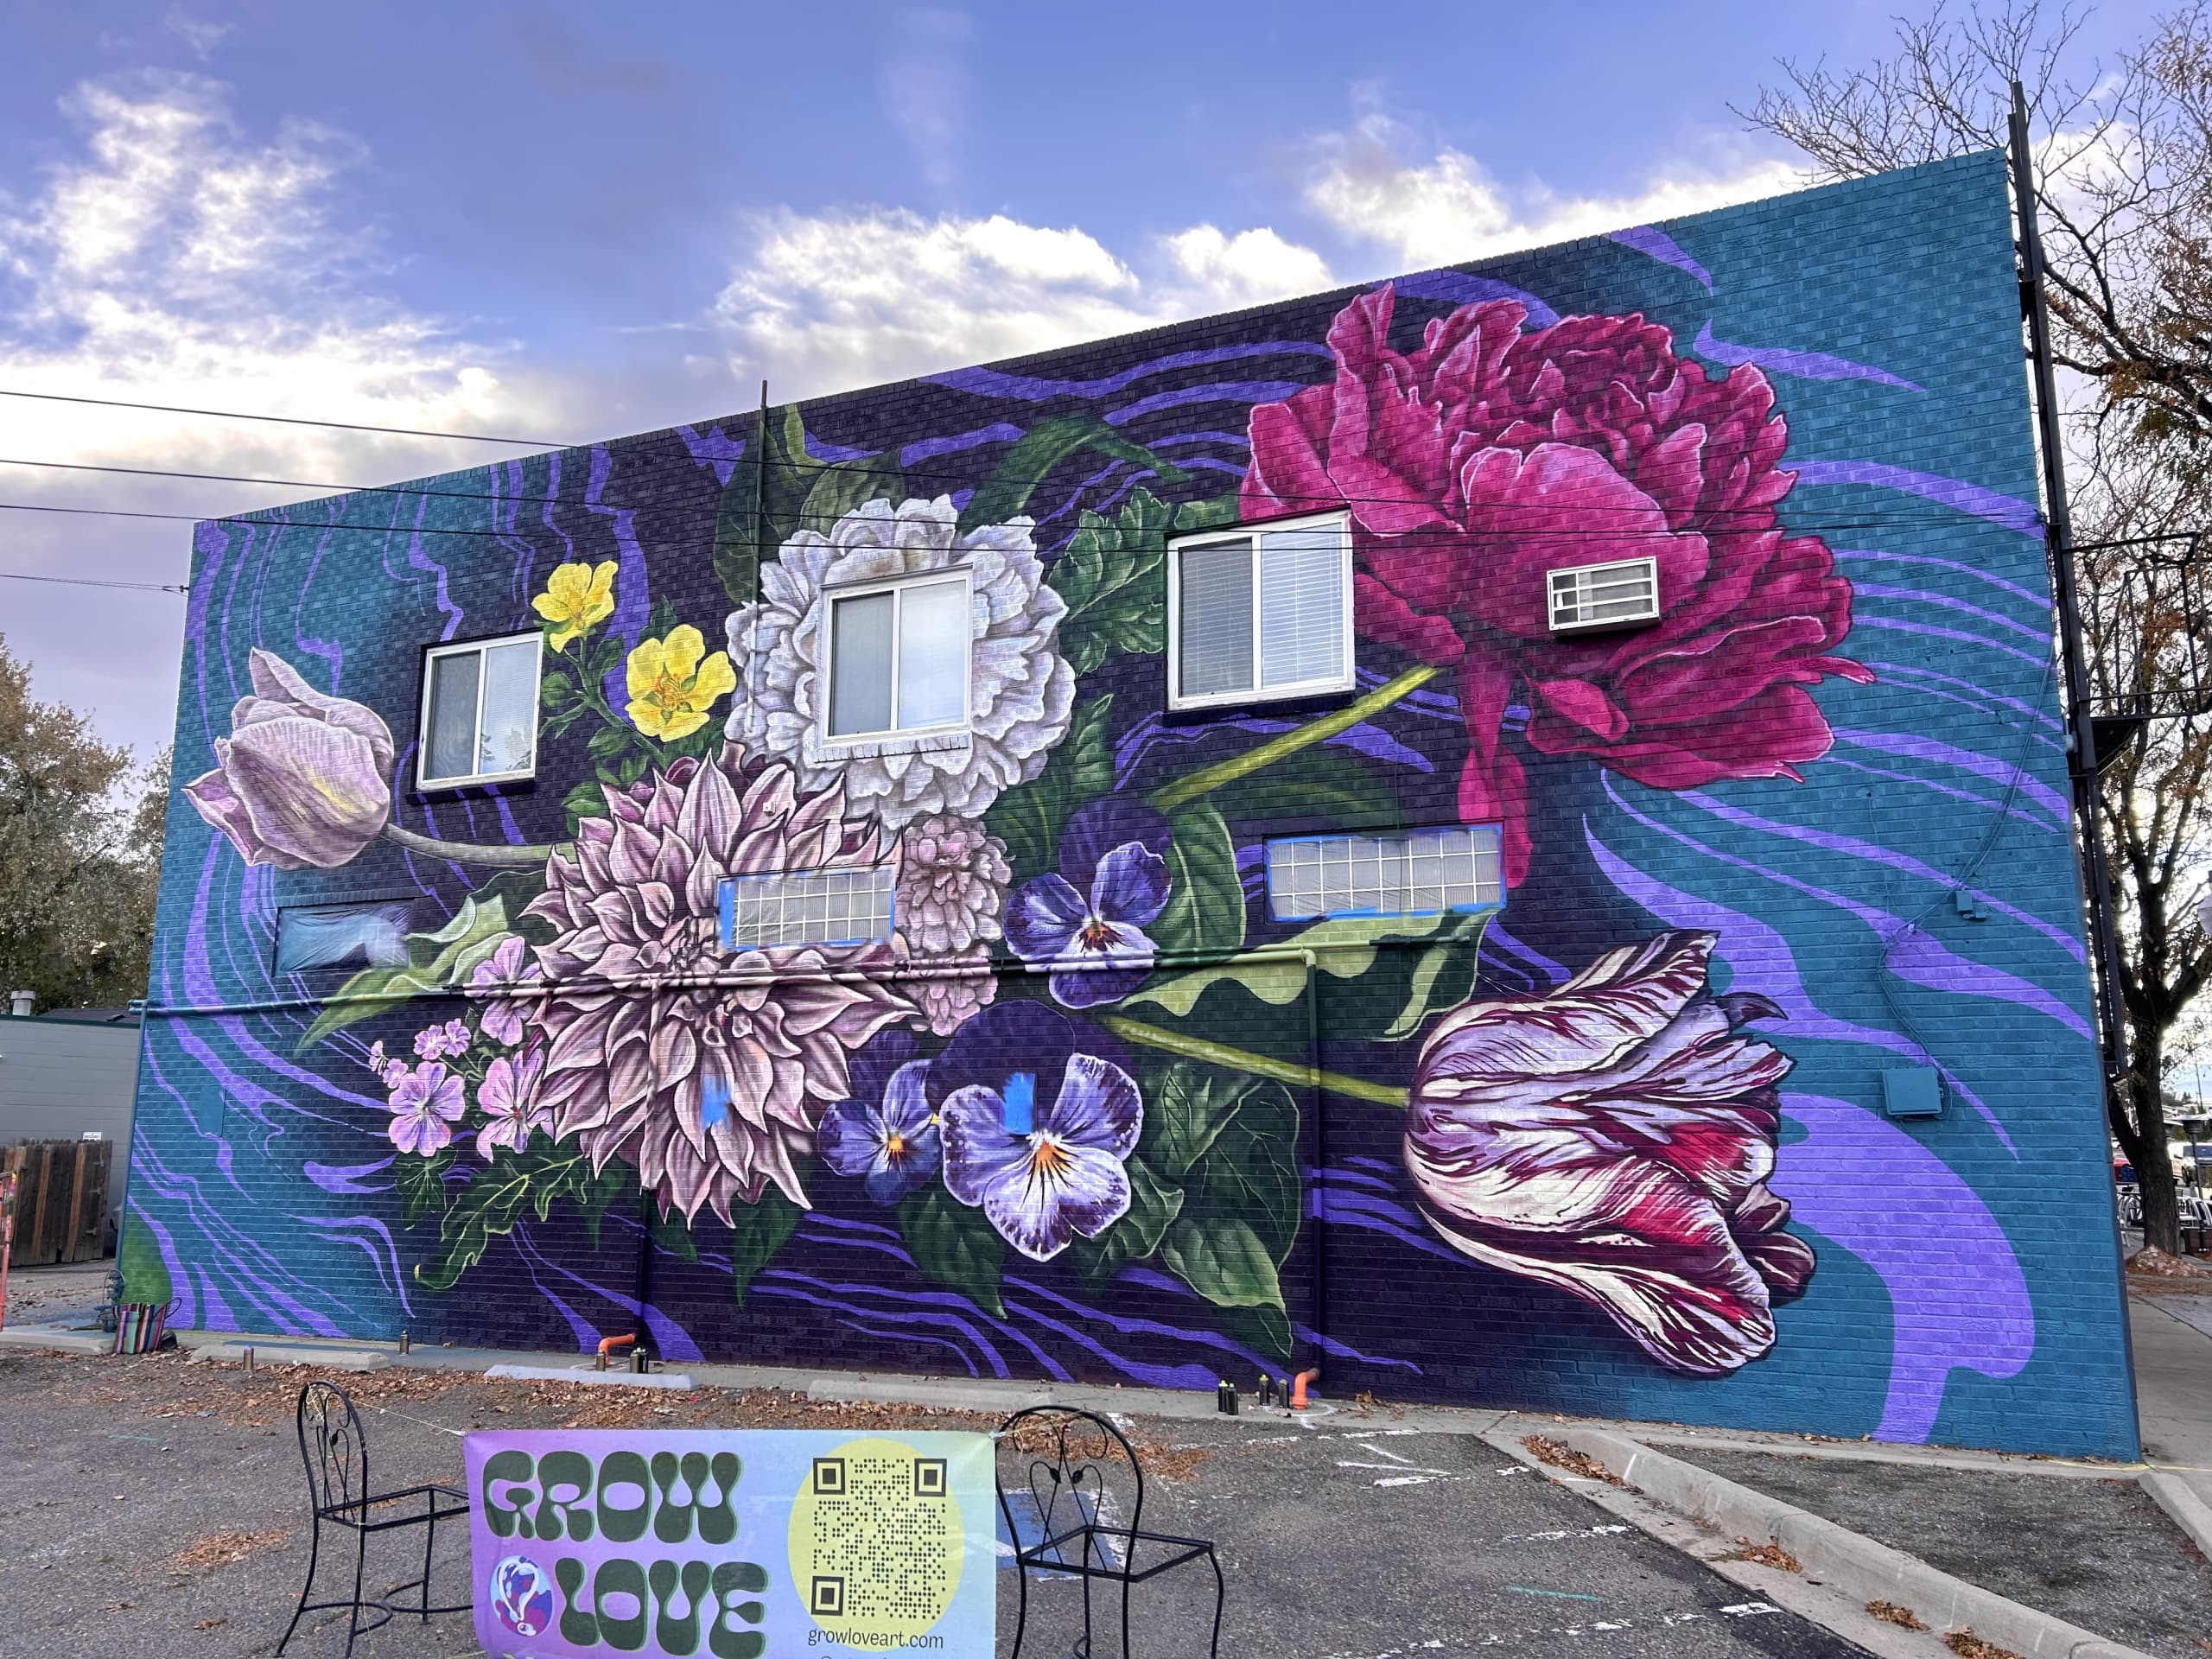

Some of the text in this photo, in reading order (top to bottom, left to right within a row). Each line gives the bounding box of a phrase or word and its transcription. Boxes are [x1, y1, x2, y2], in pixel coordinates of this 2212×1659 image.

[482, 1449, 743, 1544] GROW
[554, 1556, 770, 1659] LOVE
[807, 1627, 944, 1649] growloveart.com
